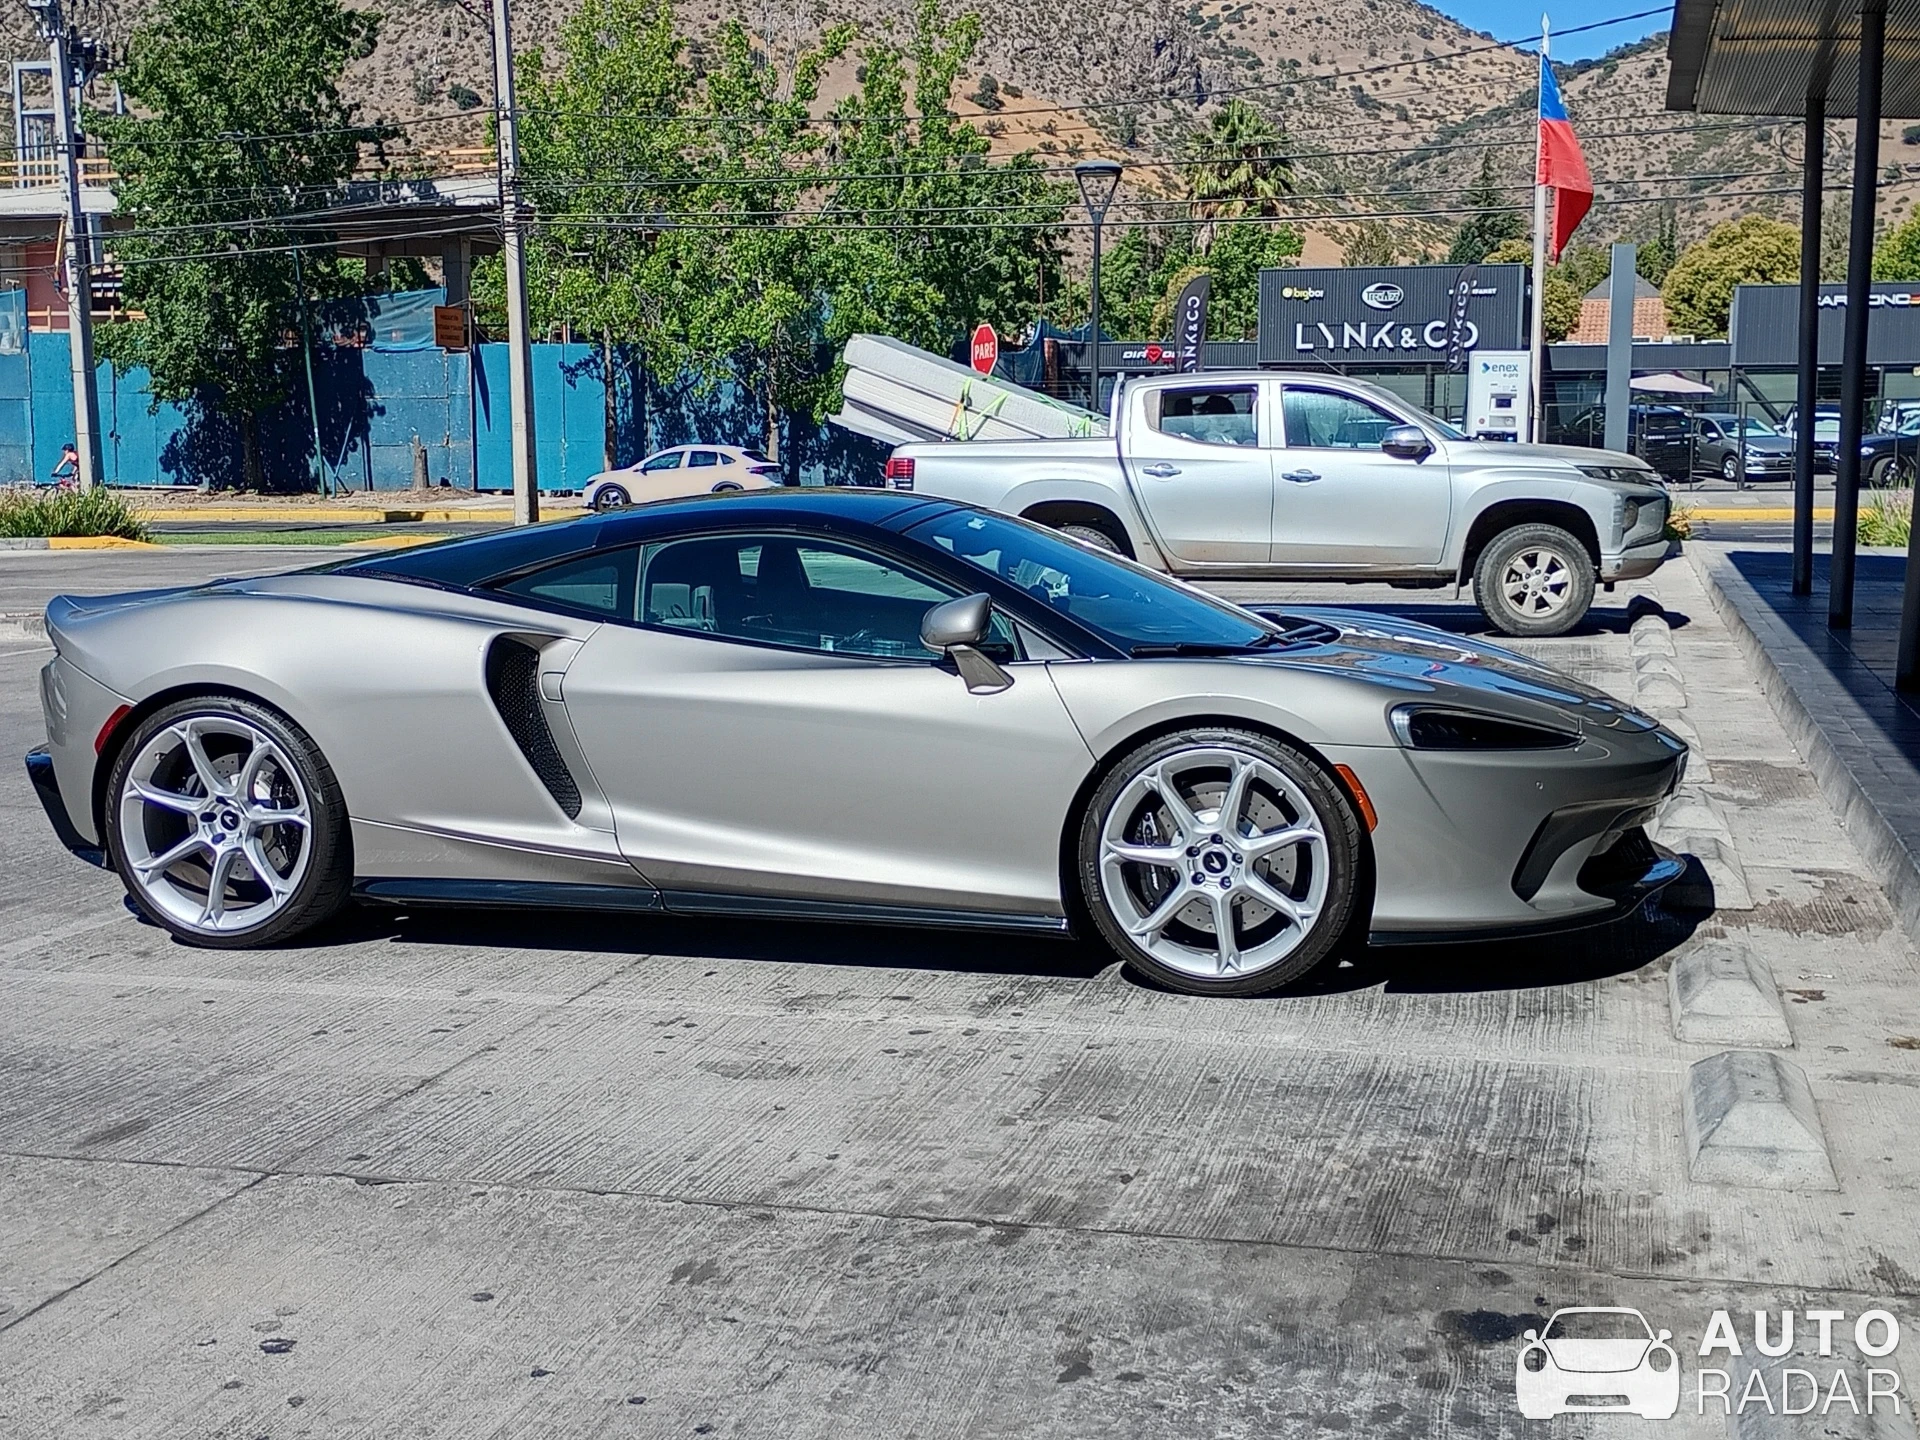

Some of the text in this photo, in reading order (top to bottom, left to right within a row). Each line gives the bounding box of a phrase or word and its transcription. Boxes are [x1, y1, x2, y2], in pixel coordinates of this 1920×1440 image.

[1296, 320, 1478, 350] LYNK&CO
[974, 341, 995, 360] PARE
[1492, 364, 1519, 372] enex
